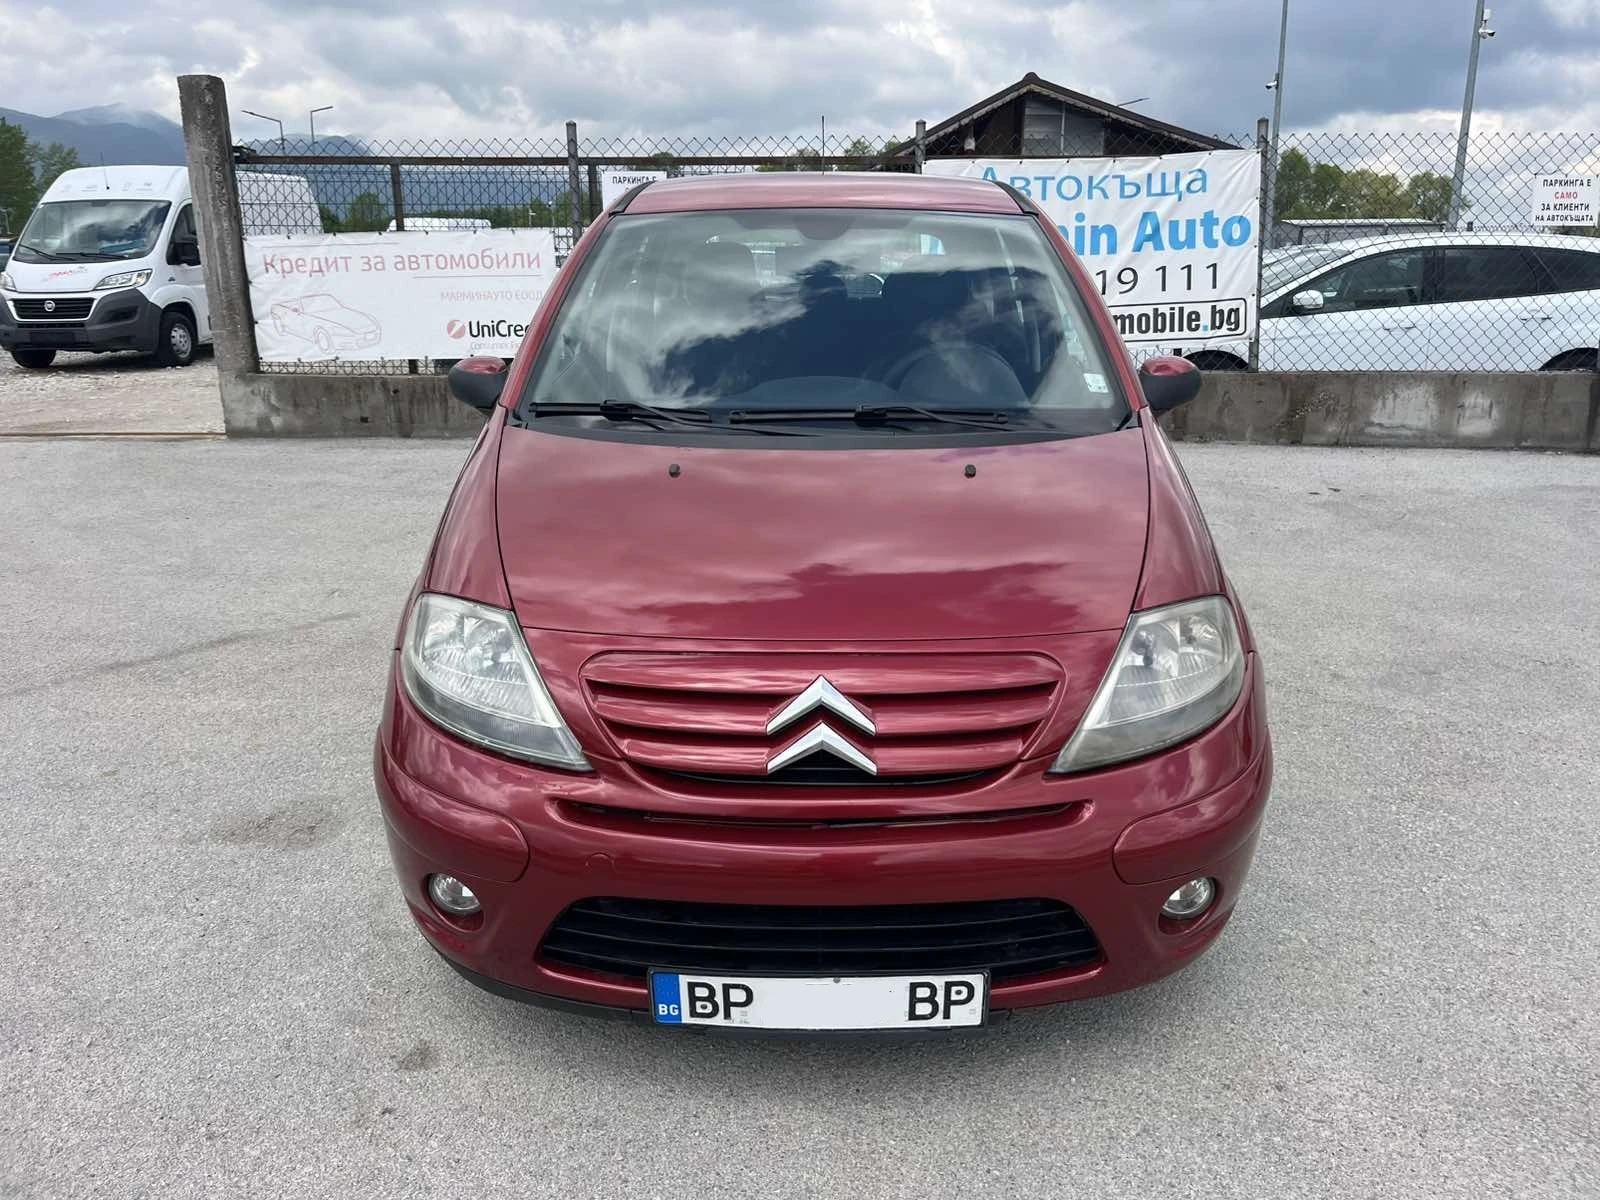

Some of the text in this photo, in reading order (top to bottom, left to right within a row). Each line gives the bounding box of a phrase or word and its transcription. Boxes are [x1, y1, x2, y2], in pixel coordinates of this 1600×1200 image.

[1543, 179, 1592, 187] ПАРКИНГА Е
[1554, 191, 1578, 199] САМО
[1541, 203, 1590, 211] ЗА КЛИЕНТИ
[1132, 209, 1252, 253] Auto
[263, 248, 541, 279] Кредит за автомобили
[1155, 262, 1218, 292] 111
[1114, 305, 1240, 335] mobile.bg
[658, 1003, 679, 1016] BG
[687, 980, 975, 1021] BP BP
